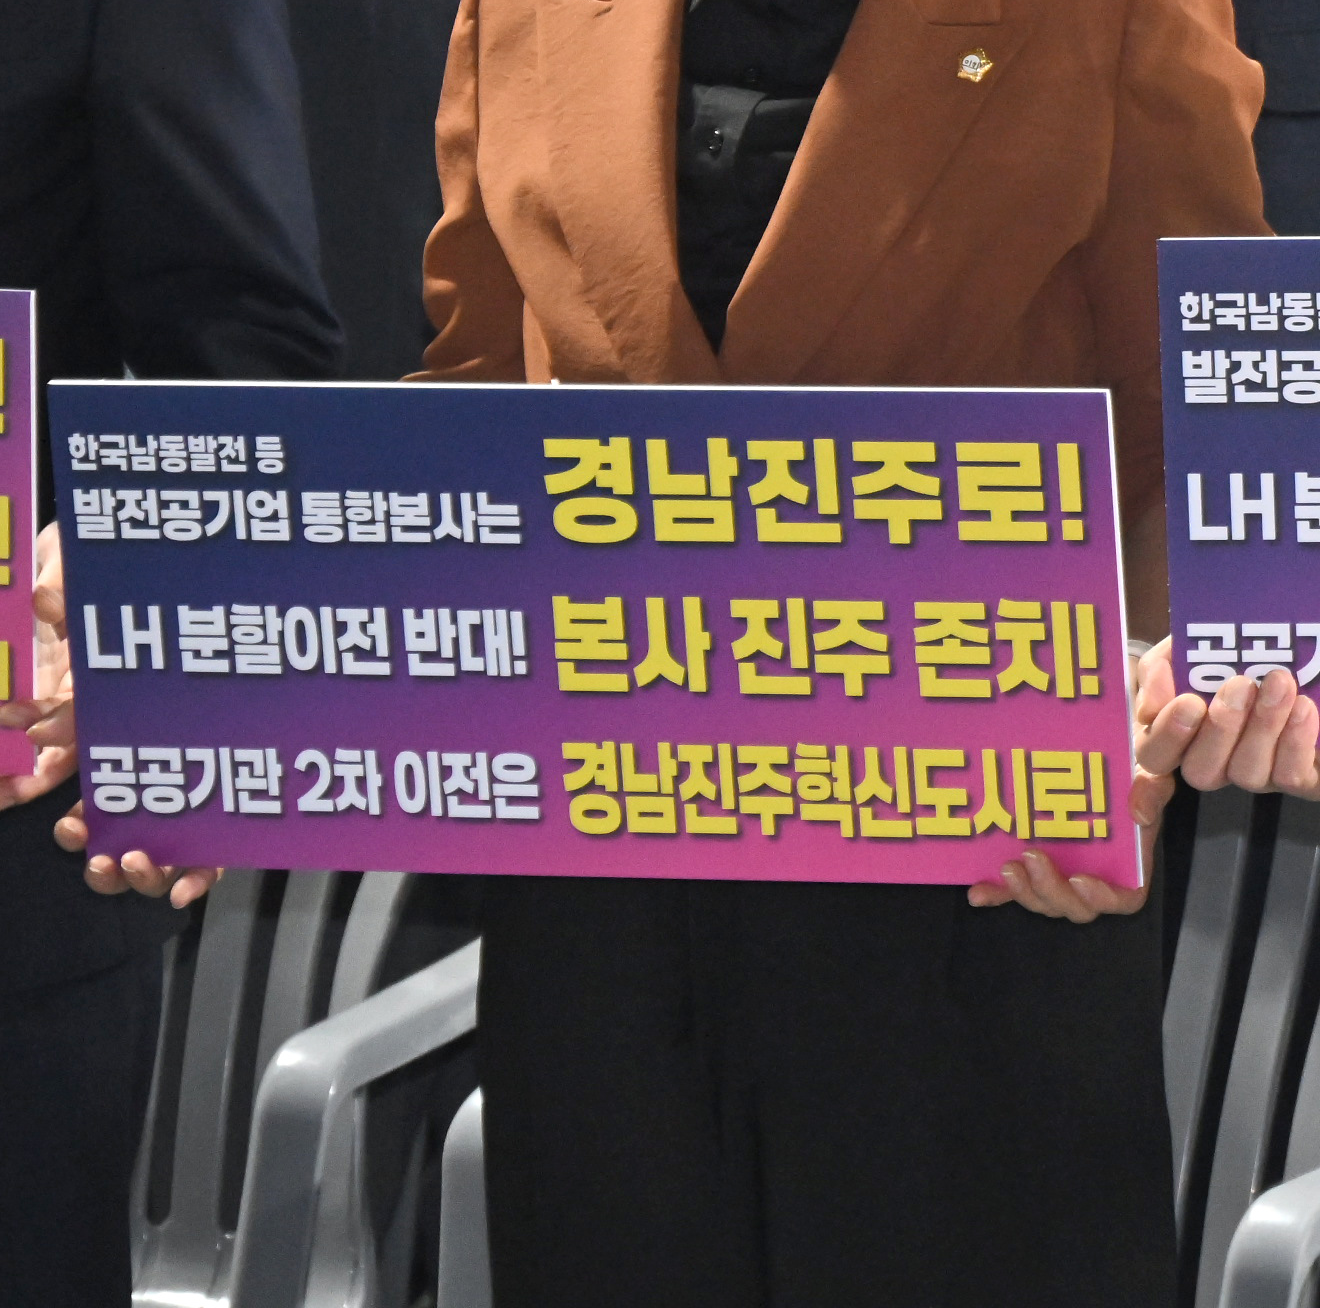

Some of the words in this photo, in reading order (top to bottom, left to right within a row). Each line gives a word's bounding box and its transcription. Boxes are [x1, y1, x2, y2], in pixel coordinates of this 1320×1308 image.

[68, 433, 247, 472] 한국남동발전
[255, 437, 283, 473] 등
[73, 489, 290, 541] 발전공기업
[301, 491, 520, 544] 통합본사는
[543, 437, 1083, 544] 경남진주로!
[1188, 473, 1276, 540] LH
[84, 605, 164, 669] LH
[178, 604, 390, 675] 분할이전
[403, 609, 526, 676] 반대!
[552, 596, 710, 692] 본사
[730, 598, 889, 696] 진주
[914, 599, 1098, 697] 존치!
[90, 747, 282, 813] 공공기관
[295, 748, 381, 815] 2차
[394, 751, 539, 819] 이전은
[562, 741, 1106, 839] 경남진주혁신도시로!
